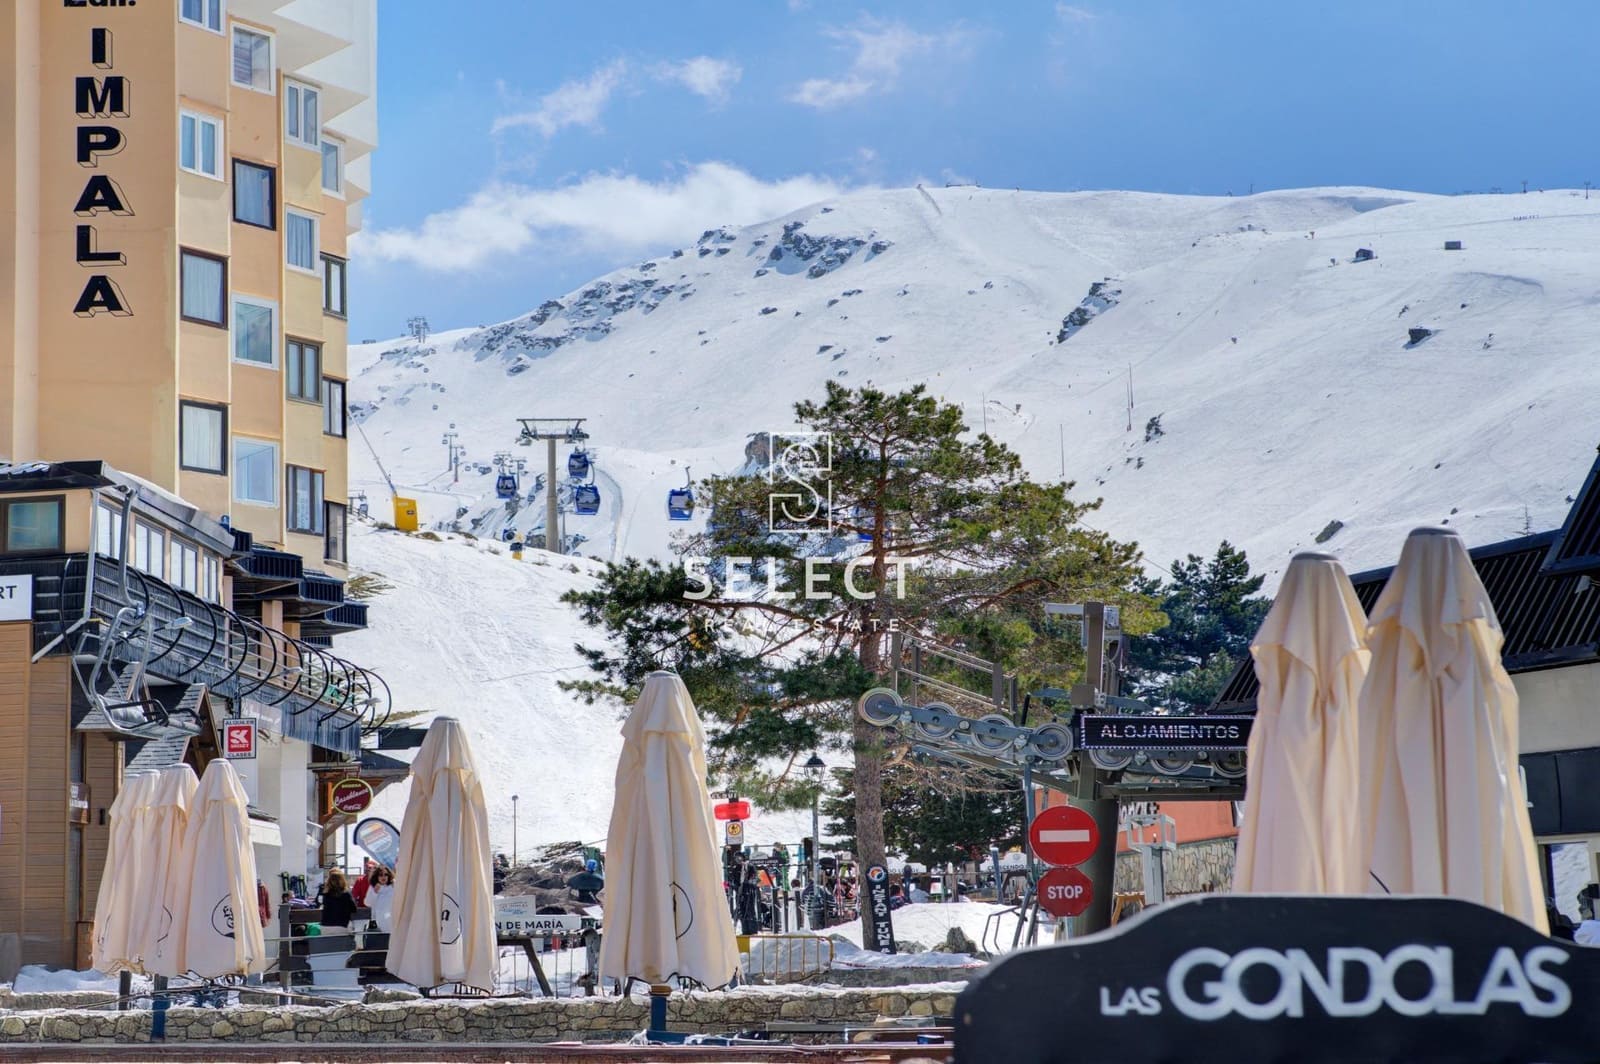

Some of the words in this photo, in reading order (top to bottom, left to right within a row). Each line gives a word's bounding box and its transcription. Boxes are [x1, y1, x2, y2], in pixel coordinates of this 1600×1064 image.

[73, 27, 136, 318] IMPALA
[1100, 724, 1240, 739] ALOJAMIENTOS
[1047, 885, 1084, 900] STOP
[506, 921, 521, 930] DE
[525, 918, 564, 930] MARÍA
[1100, 986, 1162, 1018] LAS
[1166, 945, 1572, 1021] GONDOLAS
